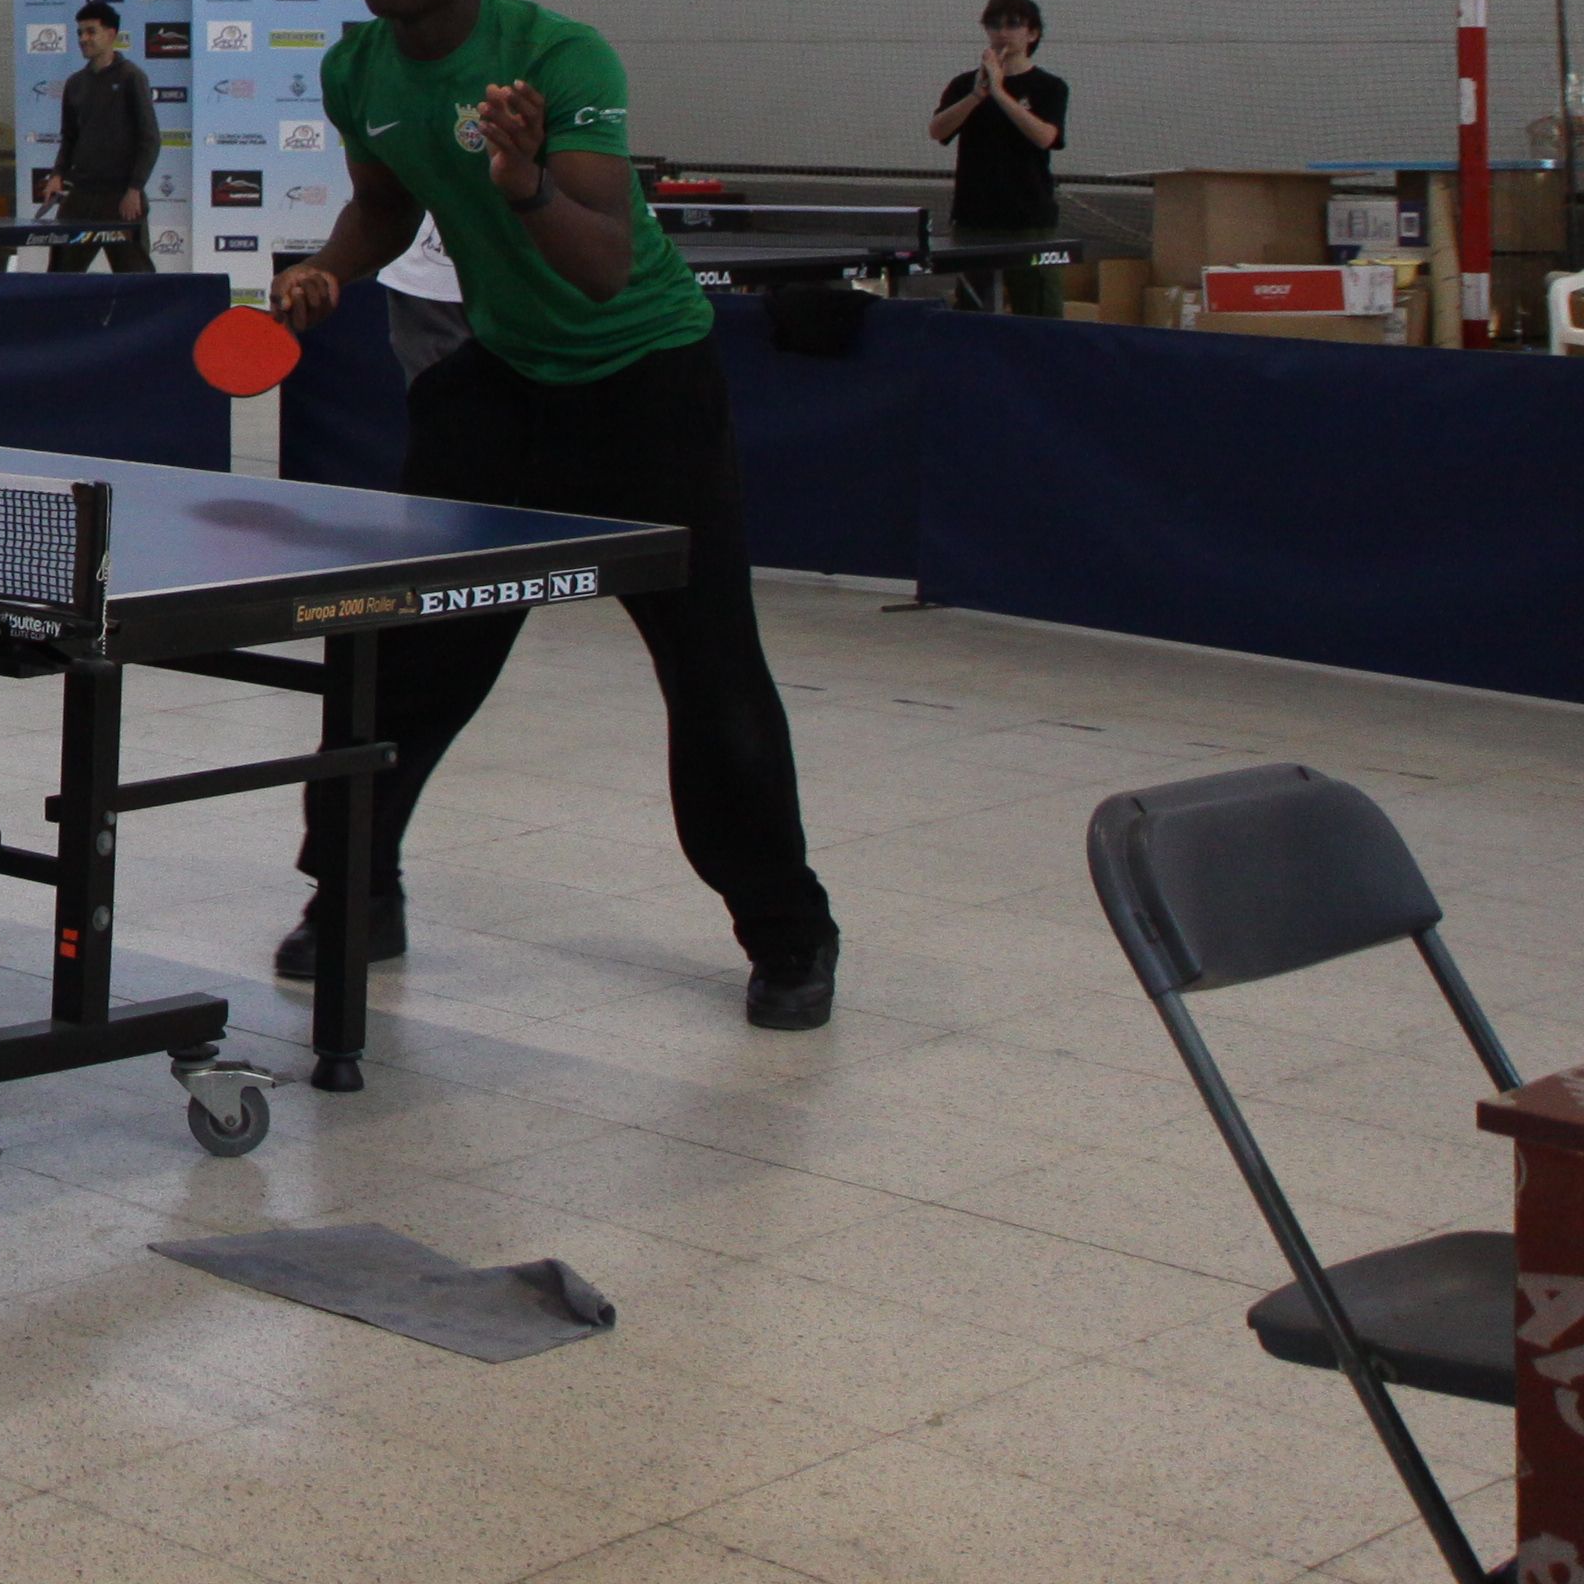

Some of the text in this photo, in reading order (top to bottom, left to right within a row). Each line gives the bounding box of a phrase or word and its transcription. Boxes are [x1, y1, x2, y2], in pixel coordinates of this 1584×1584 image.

[1038, 250, 1071, 265] JOOLA
[420, 570, 597, 615] ENEBE NB
[296, 603, 337, 623] Europa
[338, 598, 365, 617] 2000
[366, 596, 398, 614] Roller
